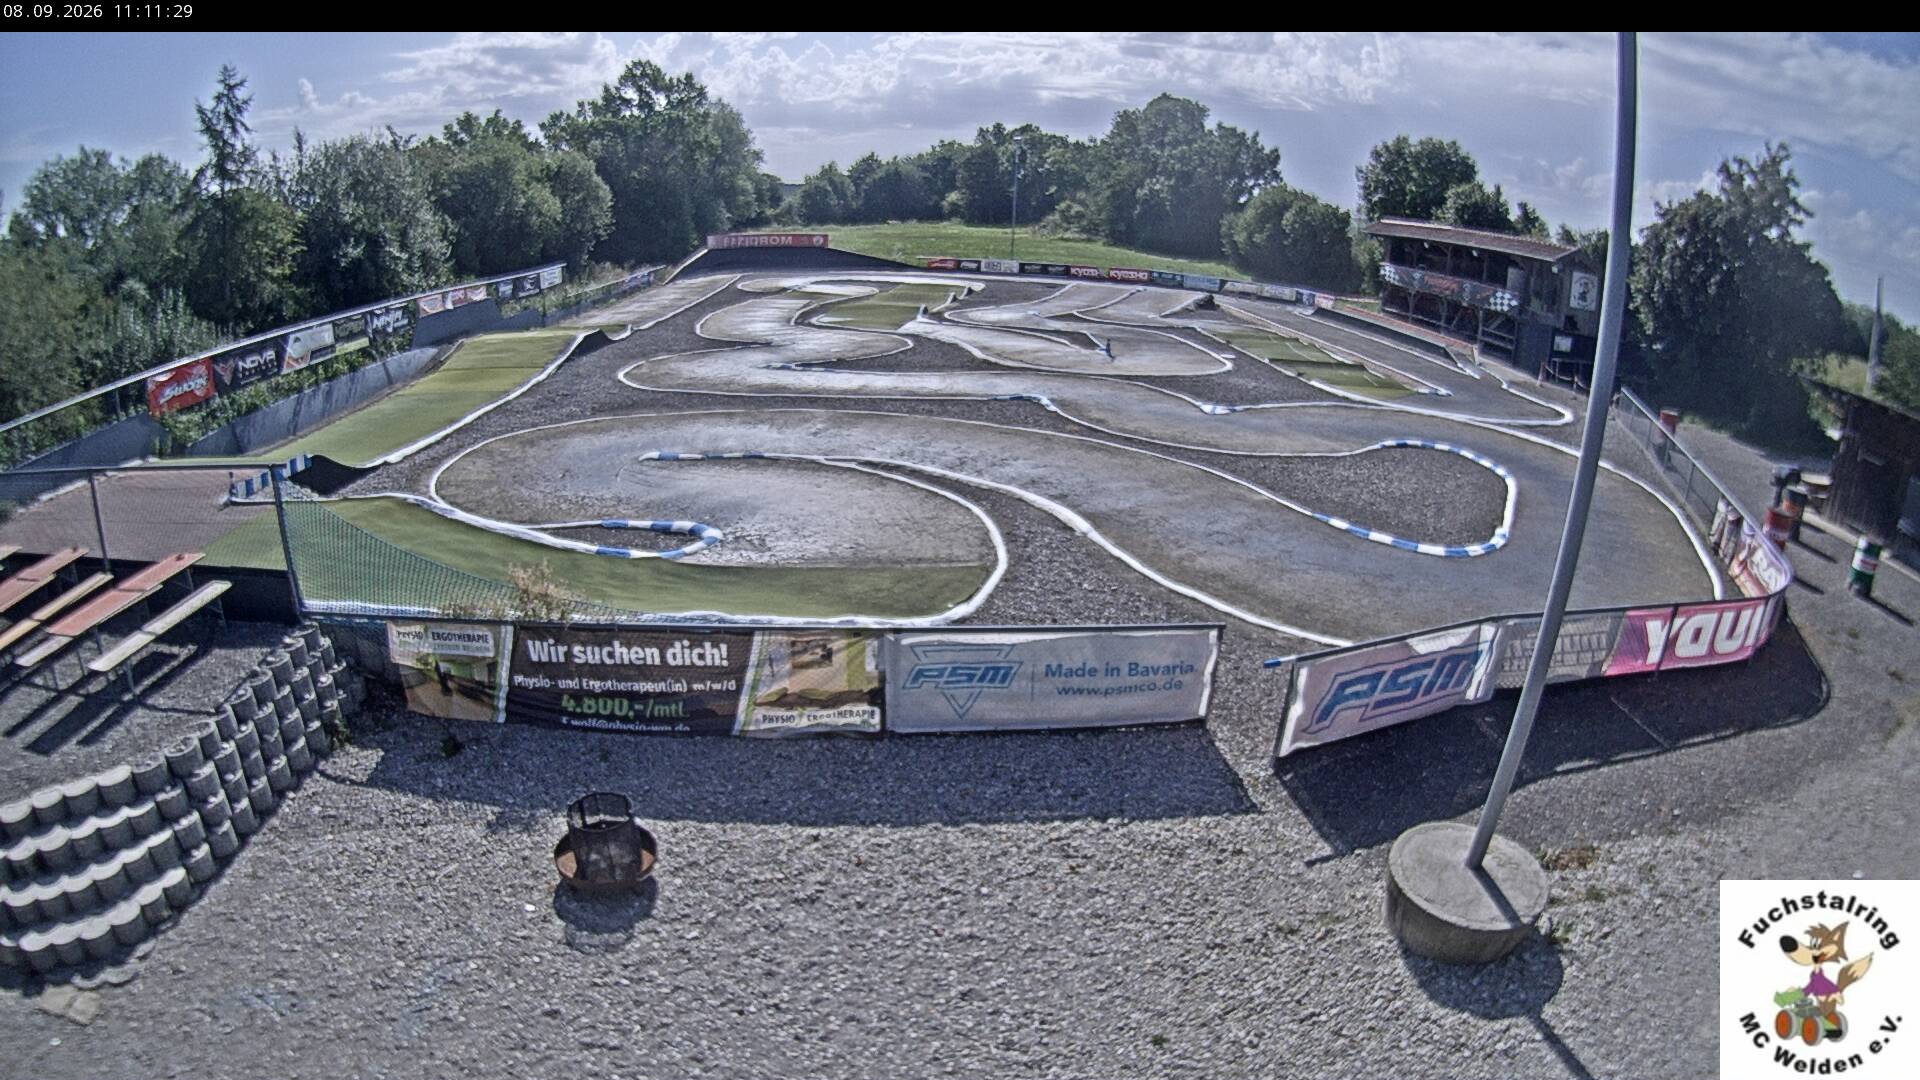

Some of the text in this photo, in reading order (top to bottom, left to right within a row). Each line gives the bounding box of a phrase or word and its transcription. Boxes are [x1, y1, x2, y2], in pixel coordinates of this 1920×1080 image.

[527, 638, 730, 667] Wir suchen dich!
[908, 663, 1016, 687] PSM
[1045, 660, 1195, 678] Made in Bavaria
[513, 675, 736, 694] Physio- und Ergotherapeut(in) m/w/d
[1056, 677, 1184, 698] www.psmco.de
[1313, 645, 1489, 726] PSM
[762, 714, 796, 724] PHYSIO
